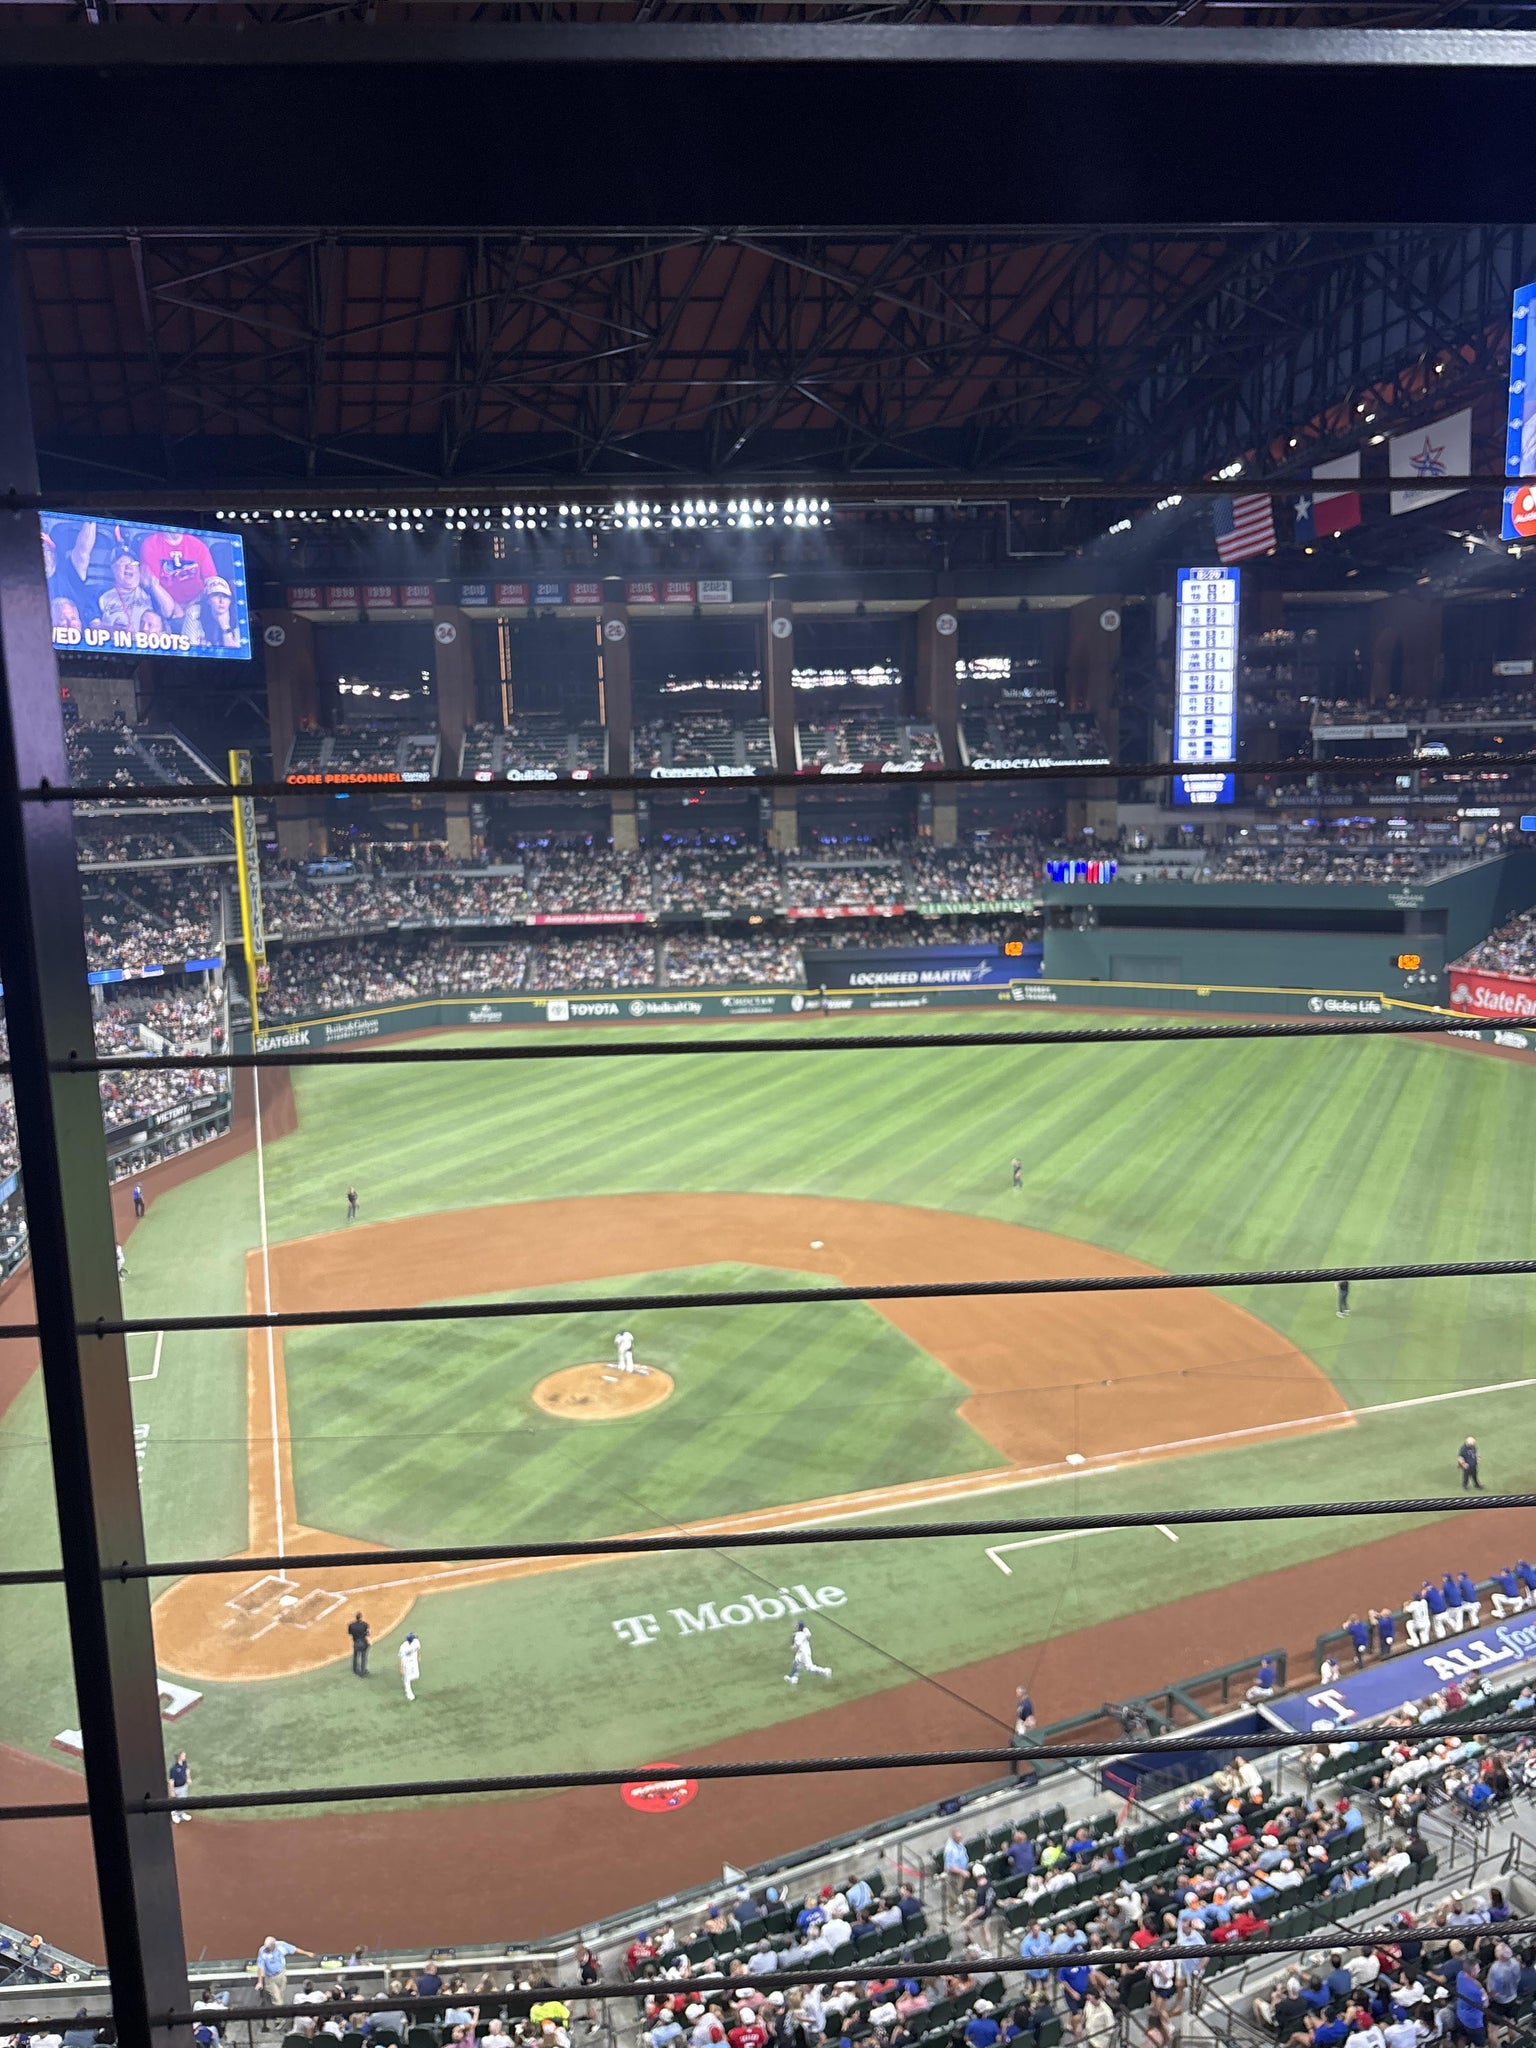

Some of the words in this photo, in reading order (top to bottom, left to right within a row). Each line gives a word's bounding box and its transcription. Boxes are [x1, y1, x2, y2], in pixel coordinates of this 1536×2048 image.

[84, 628, 111, 646] UP
[114, 630, 132, 648] IN
[135, 632, 191, 651] BOOTS
[438, 626, 453, 640] 34
[718, 764, 757, 777] Bank
[981, 758, 1051, 770] CHOCTAW
[286, 773, 322, 784] CORE
[324, 772, 403, 784] PERSONNEL
[849, 970, 918, 985] LOCKHEED
[919, 969, 972, 984] MARTIN
[570, 1003, 619, 1017] TOYOTA
[1324, 998, 1358, 1012] Globe
[1358, 1000, 1382, 1014] Life
[256, 1029, 311, 1053] SEATGEEK
[611, 1612, 661, 1647] T
[667, 1584, 849, 1637] Mobile
[1423, 1639, 1514, 1682] ALL
[1306, 1688, 1360, 1725] T
